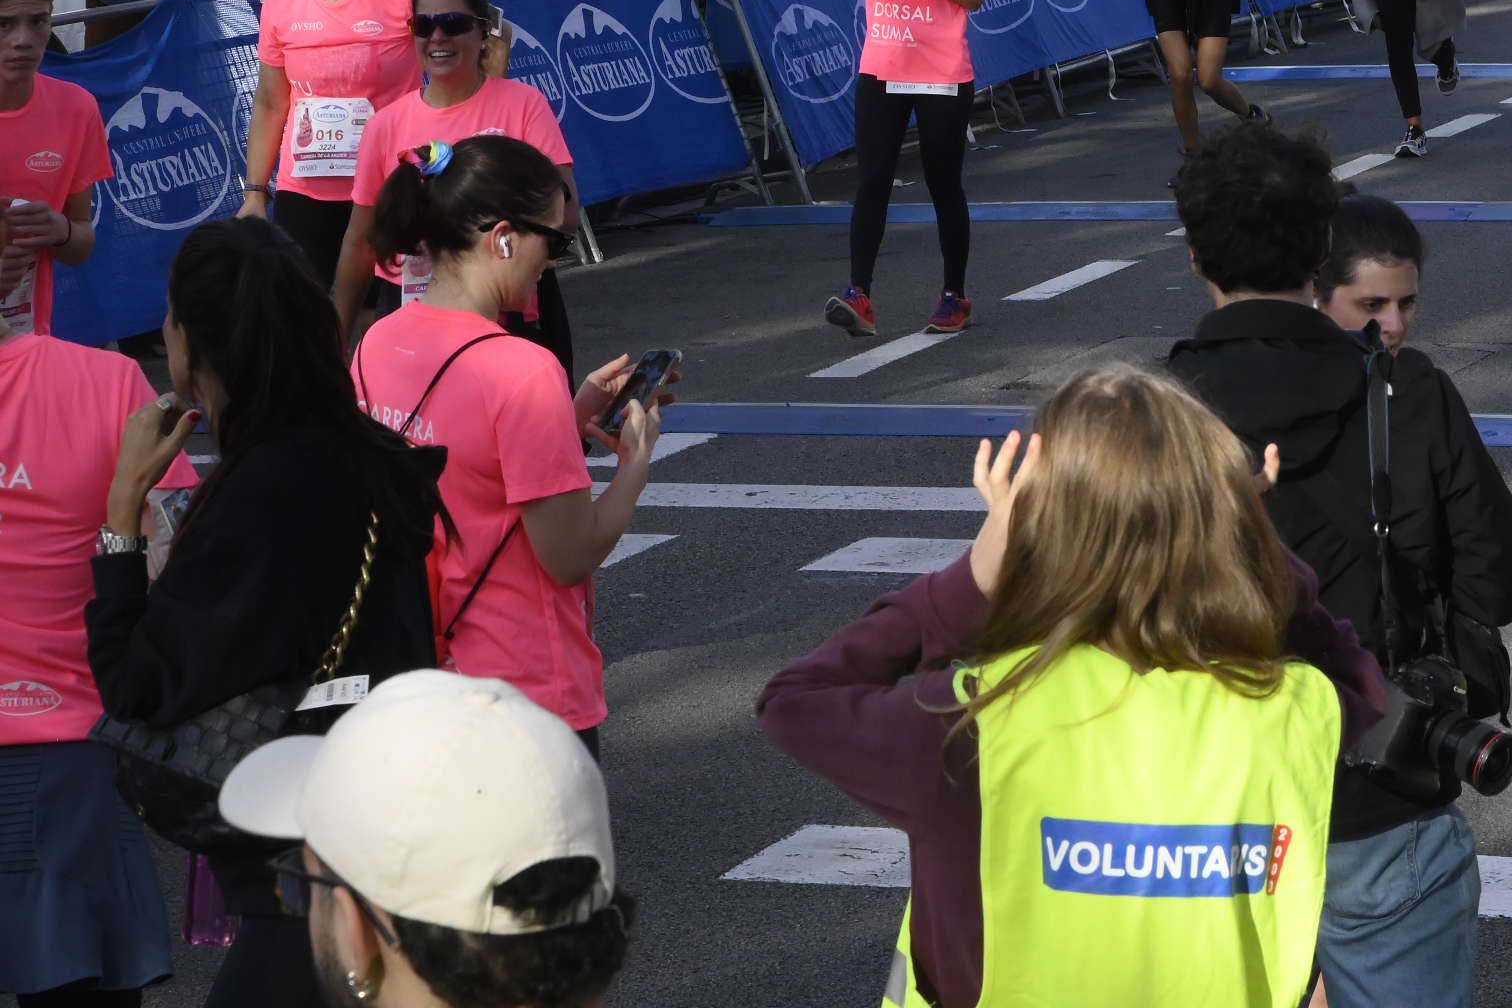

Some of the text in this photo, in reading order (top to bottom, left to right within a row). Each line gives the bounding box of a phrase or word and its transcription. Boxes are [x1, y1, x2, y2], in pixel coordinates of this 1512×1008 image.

[874, 1, 934, 22] DORSAL
[870, 23, 915, 42] SUMA
[566, 51, 651, 97] ASTURIANA
[289, 79, 313, 97] TU
[122, 135, 166, 154] CENTRAL
[315, 129, 344, 141] 016
[111, 141, 225, 202] ASTURIANA
